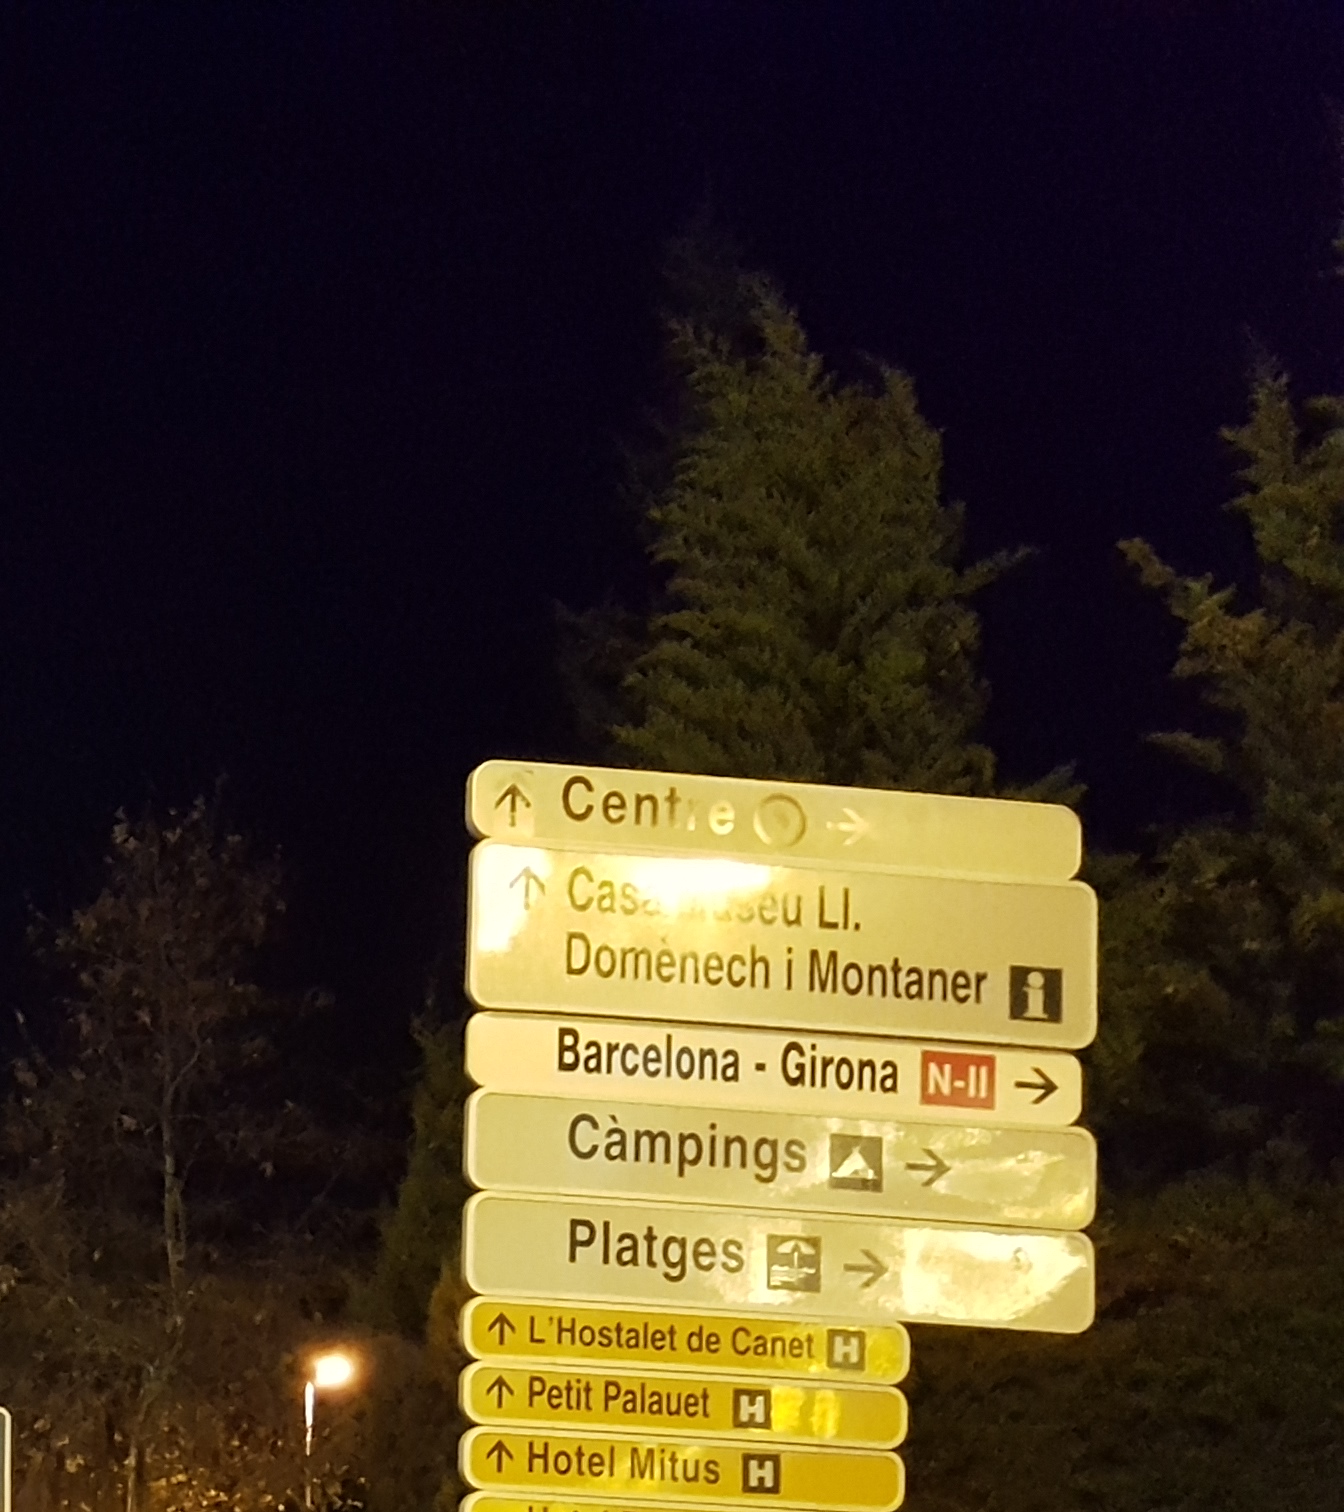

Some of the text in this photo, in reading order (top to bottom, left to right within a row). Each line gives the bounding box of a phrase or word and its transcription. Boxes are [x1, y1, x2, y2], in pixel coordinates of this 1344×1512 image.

[561, 774, 736, 836] Centre
[565, 930, 772, 990] Domènech
[785, 947, 794, 990] i
[809, 949, 989, 1006] Montaner
[558, 1027, 741, 1084] Barcelona
[781, 1042, 899, 1094] Girona
[567, 1112, 808, 1184] Càmpings
[567, 1217, 745, 1283] Platges
[528, 1315, 679, 1353] L'Hostalet
[687, 1324, 722, 1355] de
[731, 1327, 816, 1361] Canet
[528, 1376, 594, 1412] Petit
[603, 1381, 711, 1420] Palauet
[528, 1441, 615, 1478] Hotel
[630, 1447, 721, 1486] Mitus
